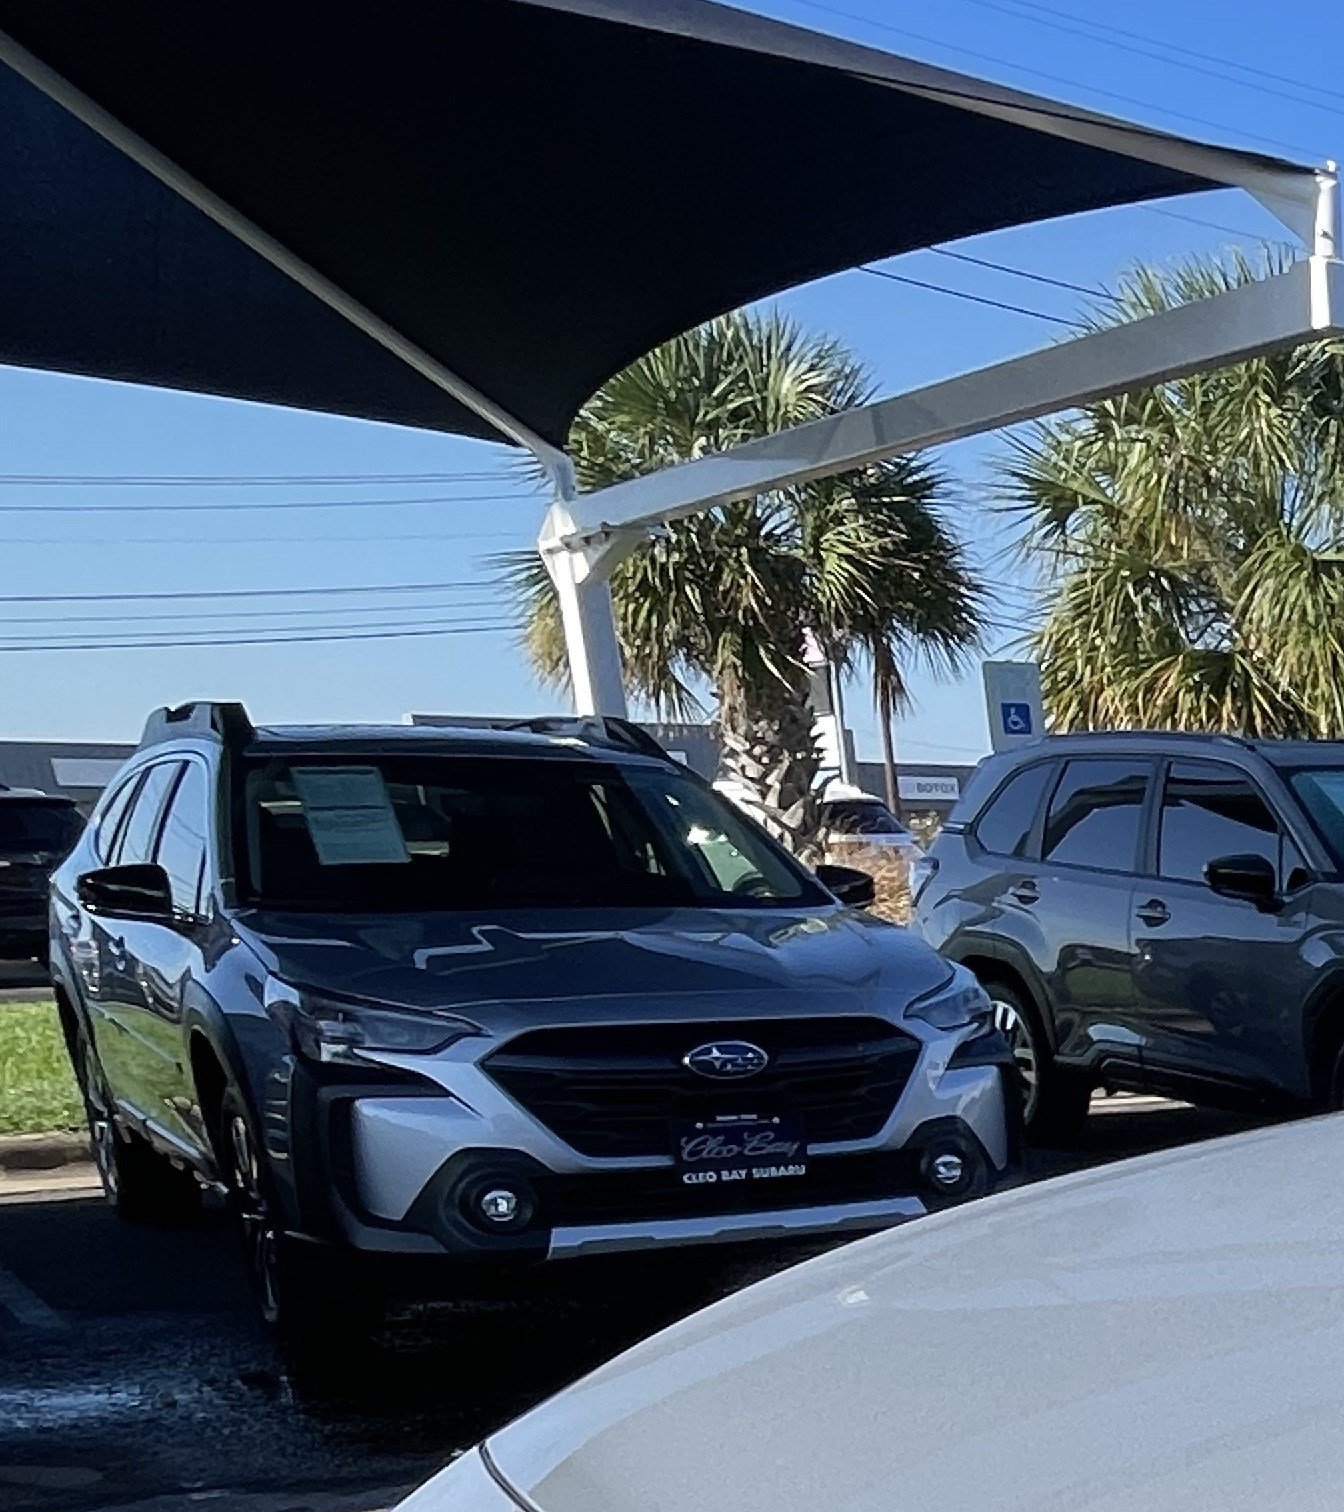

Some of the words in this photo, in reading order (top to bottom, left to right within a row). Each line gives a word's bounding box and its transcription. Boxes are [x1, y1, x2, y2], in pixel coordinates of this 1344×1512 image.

[683, 1171, 717, 1184] CLEO
[720, 1168, 747, 1181] BAY
[752, 1164, 806, 1179] SUBARU
